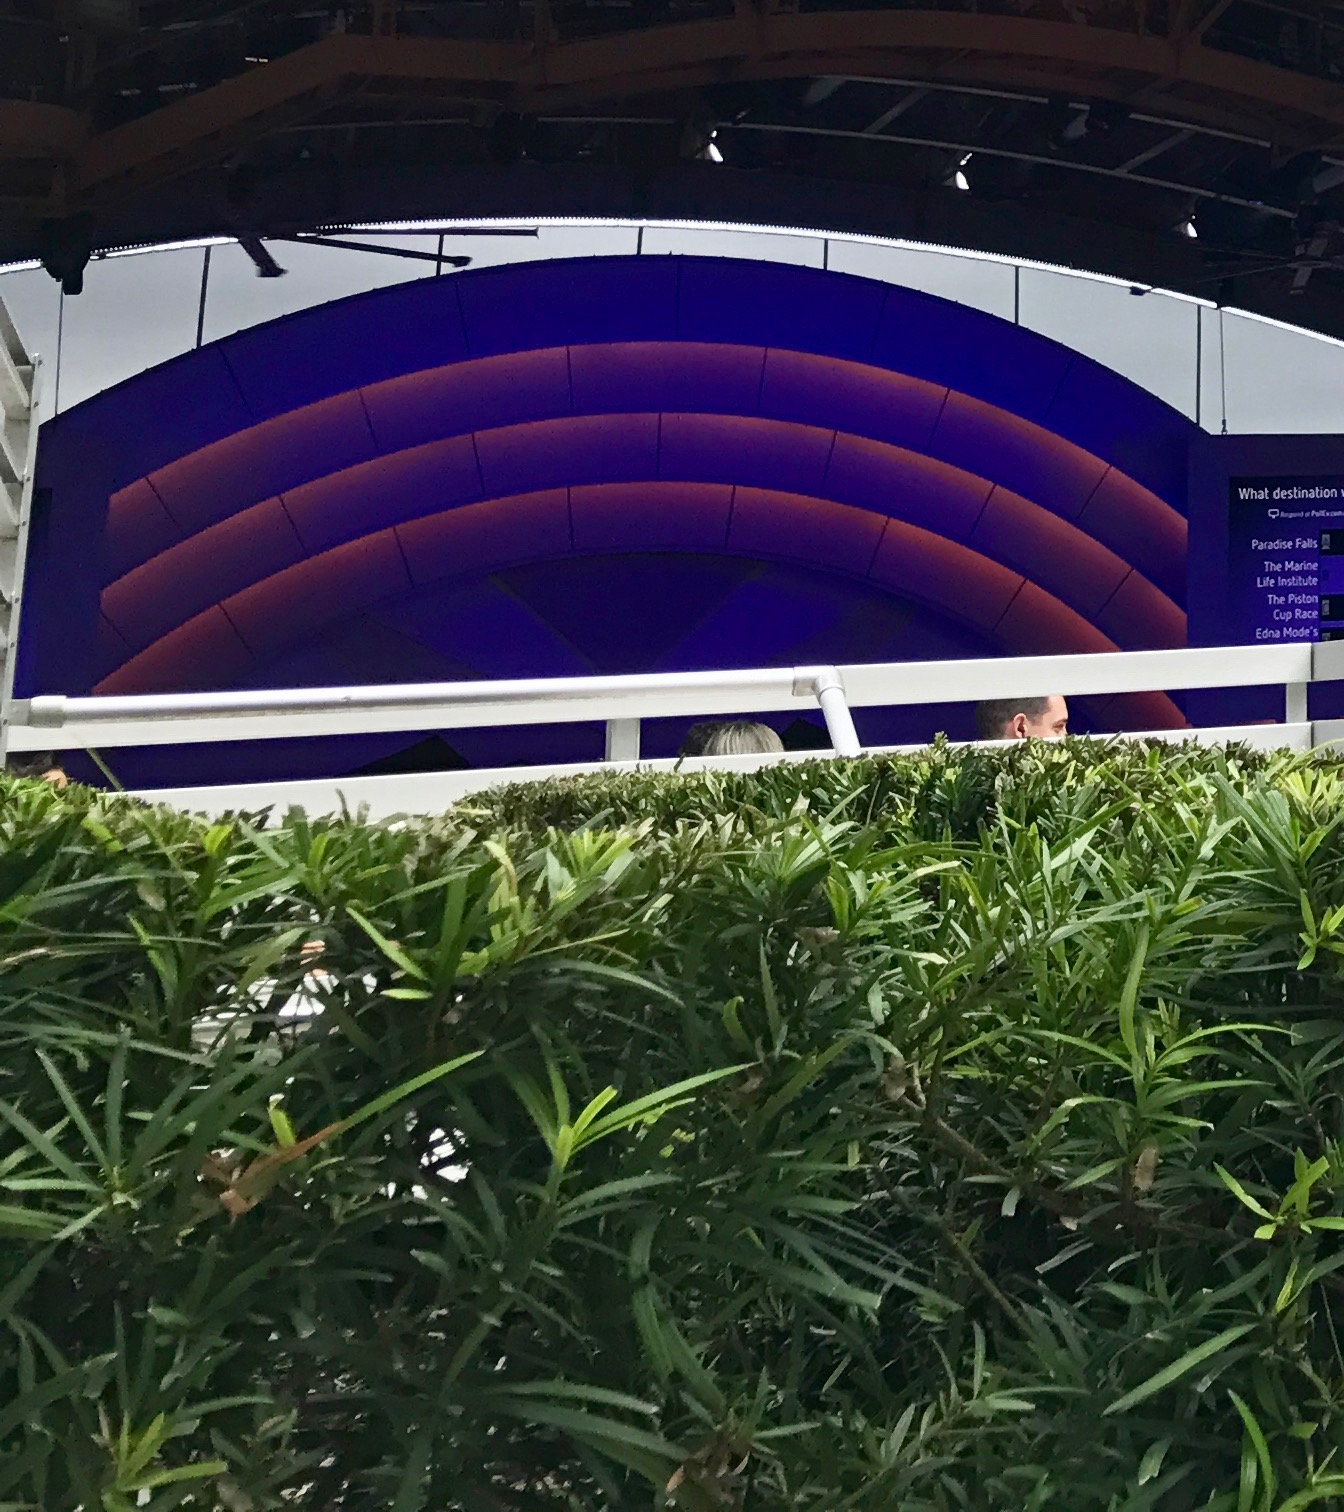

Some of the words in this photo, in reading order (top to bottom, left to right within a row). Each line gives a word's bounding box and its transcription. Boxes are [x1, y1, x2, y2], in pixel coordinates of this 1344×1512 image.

[1238, 487, 1270, 500] What
[1272, 486, 1338, 500] destination
[1251, 538, 1293, 550] Paradise
[1295, 537, 1318, 549] Falls
[1264, 561, 1282, 572] The
[1284, 560, 1319, 571] Marine
[1256, 576, 1275, 588] Life
[1277, 574, 1319, 587] Institute
[1267, 594, 1285, 605] The
[1287, 593, 1319, 604] Piston
[1273, 609, 1292, 622] Cup
[1294, 608, 1319, 619] Race
[1255, 628, 1280, 639] Edna
[1282, 626, 1319, 638] Mode's
